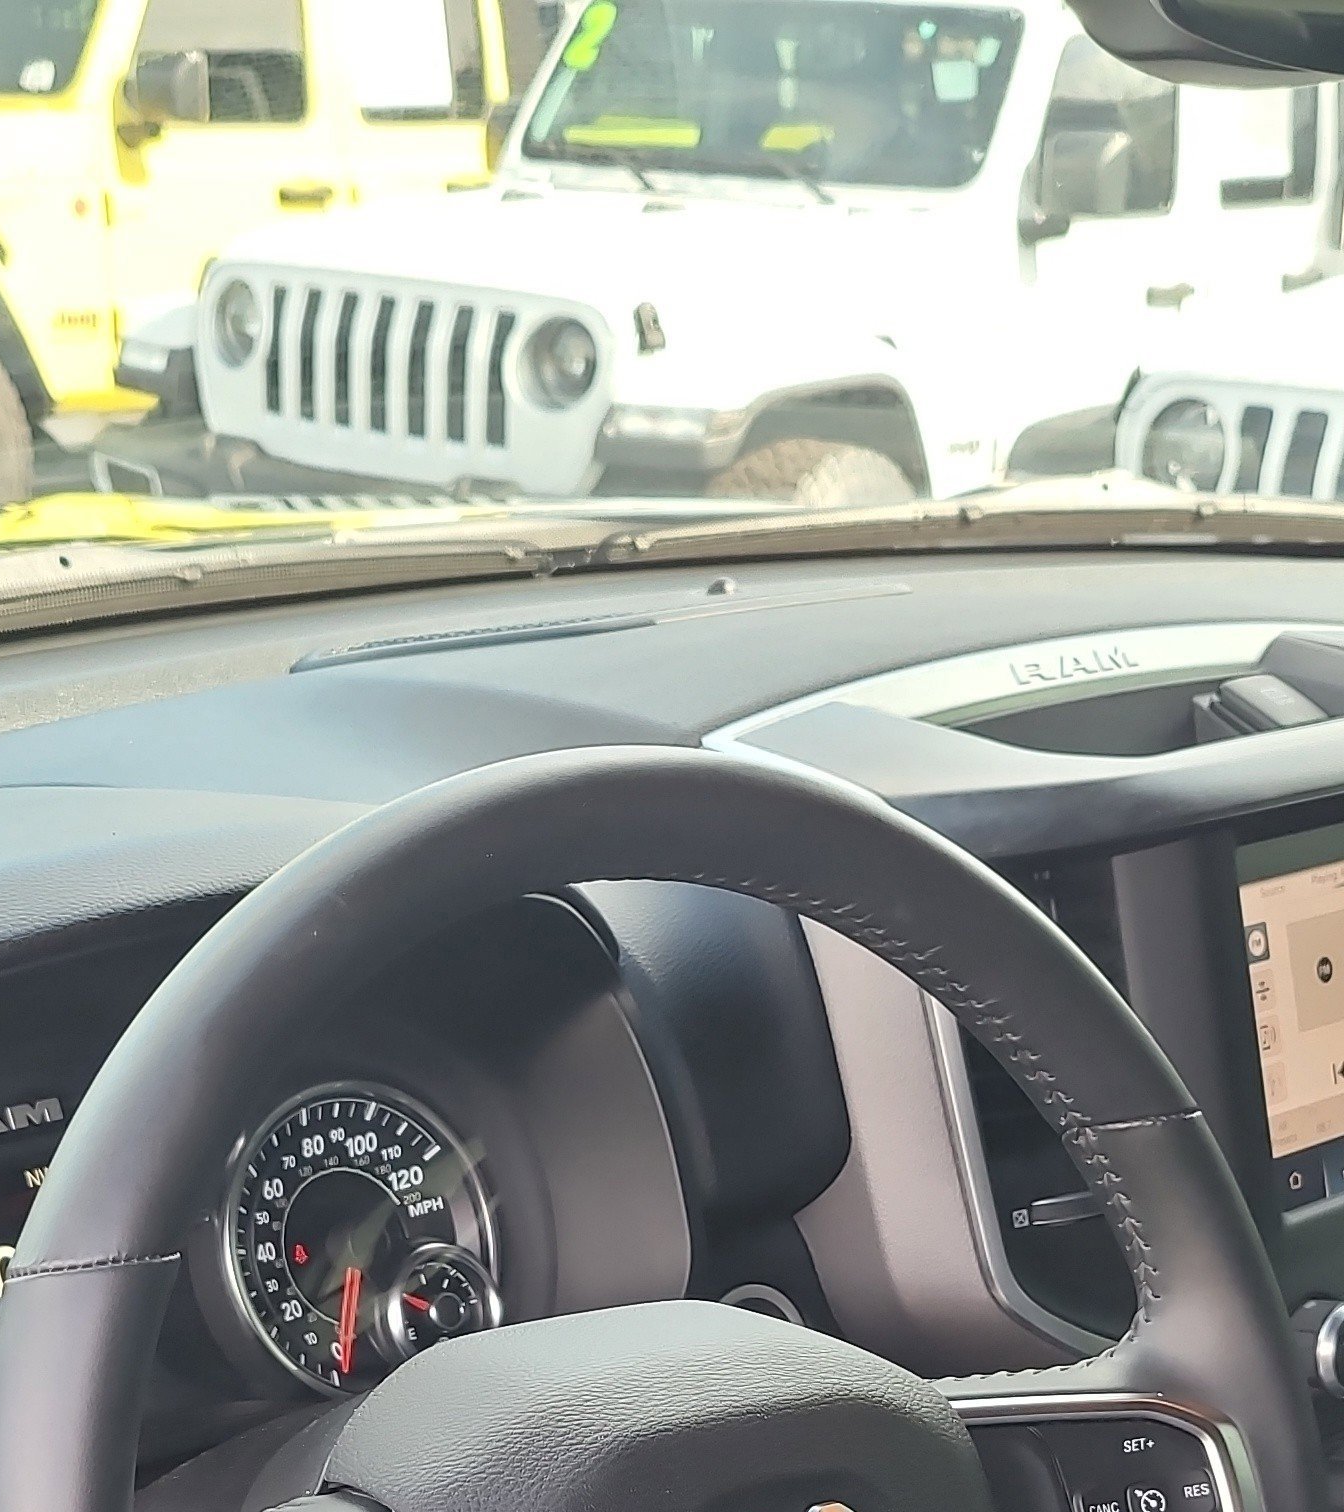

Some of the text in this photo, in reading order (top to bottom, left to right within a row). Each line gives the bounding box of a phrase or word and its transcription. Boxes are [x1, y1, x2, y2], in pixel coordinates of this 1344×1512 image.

[1009, 645, 1139, 686] RAM
[329, 1127, 346, 1143] 90
[344, 1131, 378, 1158] 100
[301, 1134, 325, 1158] 80
[381, 1145, 402, 1161] 110
[281, 1155, 296, 1170] 70
[387, 1165, 424, 1192] 120
[262, 1178, 284, 1200] 60
[407, 1197, 444, 1219] MPH
[256, 1211, 270, 1225] 50
[256, 1241, 276, 1263] 40
[266, 1279, 279, 1293] 30
[281, 1299, 303, 1322] 20
[304, 1332, 318, 1346] 10
[407, 1328, 417, 1341] E
[1183, 1483, 1210, 1498] RES
